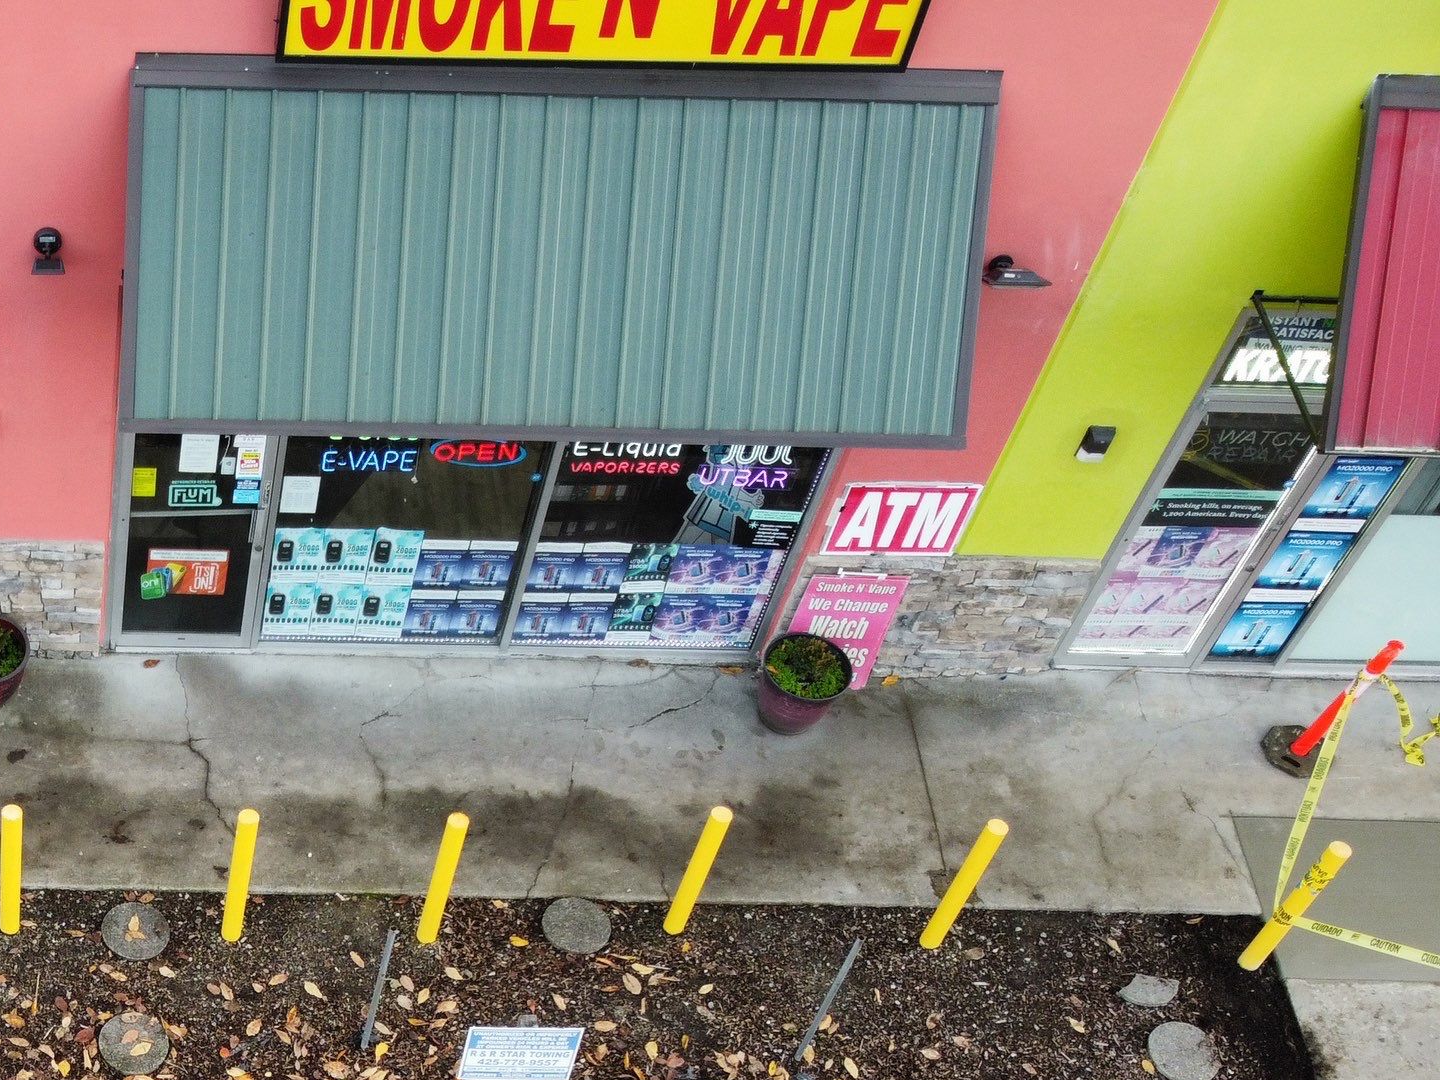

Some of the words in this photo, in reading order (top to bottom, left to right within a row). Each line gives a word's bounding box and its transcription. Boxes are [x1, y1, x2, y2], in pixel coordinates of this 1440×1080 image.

[300, 0, 576, 53] SMOKE
[708, 0, 912, 57] VAPE
[1271, 327, 1335, 339] SATISFAC
[1218, 429, 1311, 447] WATCH
[321, 450, 418, 472] E-VAPE
[434, 442, 520, 462] OPEN
[570, 461, 682, 475] VAPORIZERS
[1375, 465, 1393, 473] PRO
[700, 467, 789, 489] UTBAR
[173, 487, 212, 503] FLUM
[1166, 502, 1201, 510] Smoking
[1185, 510, 1227, 518] Americans.
[1229, 511, 1251, 519] Every
[835, 491, 970, 549] ATM
[816, 582, 854, 593] Smoke
[869, 584, 897, 595] Vape
[808, 597, 831, 611] We
[833, 599, 889, 614] Change
[809, 616, 870, 639] Watch
[1311, 922, 1343, 938] CUIDADO
[1370, 938, 1402, 954] CAUTION
[1421, 952, 1440, 966] CUIDA
